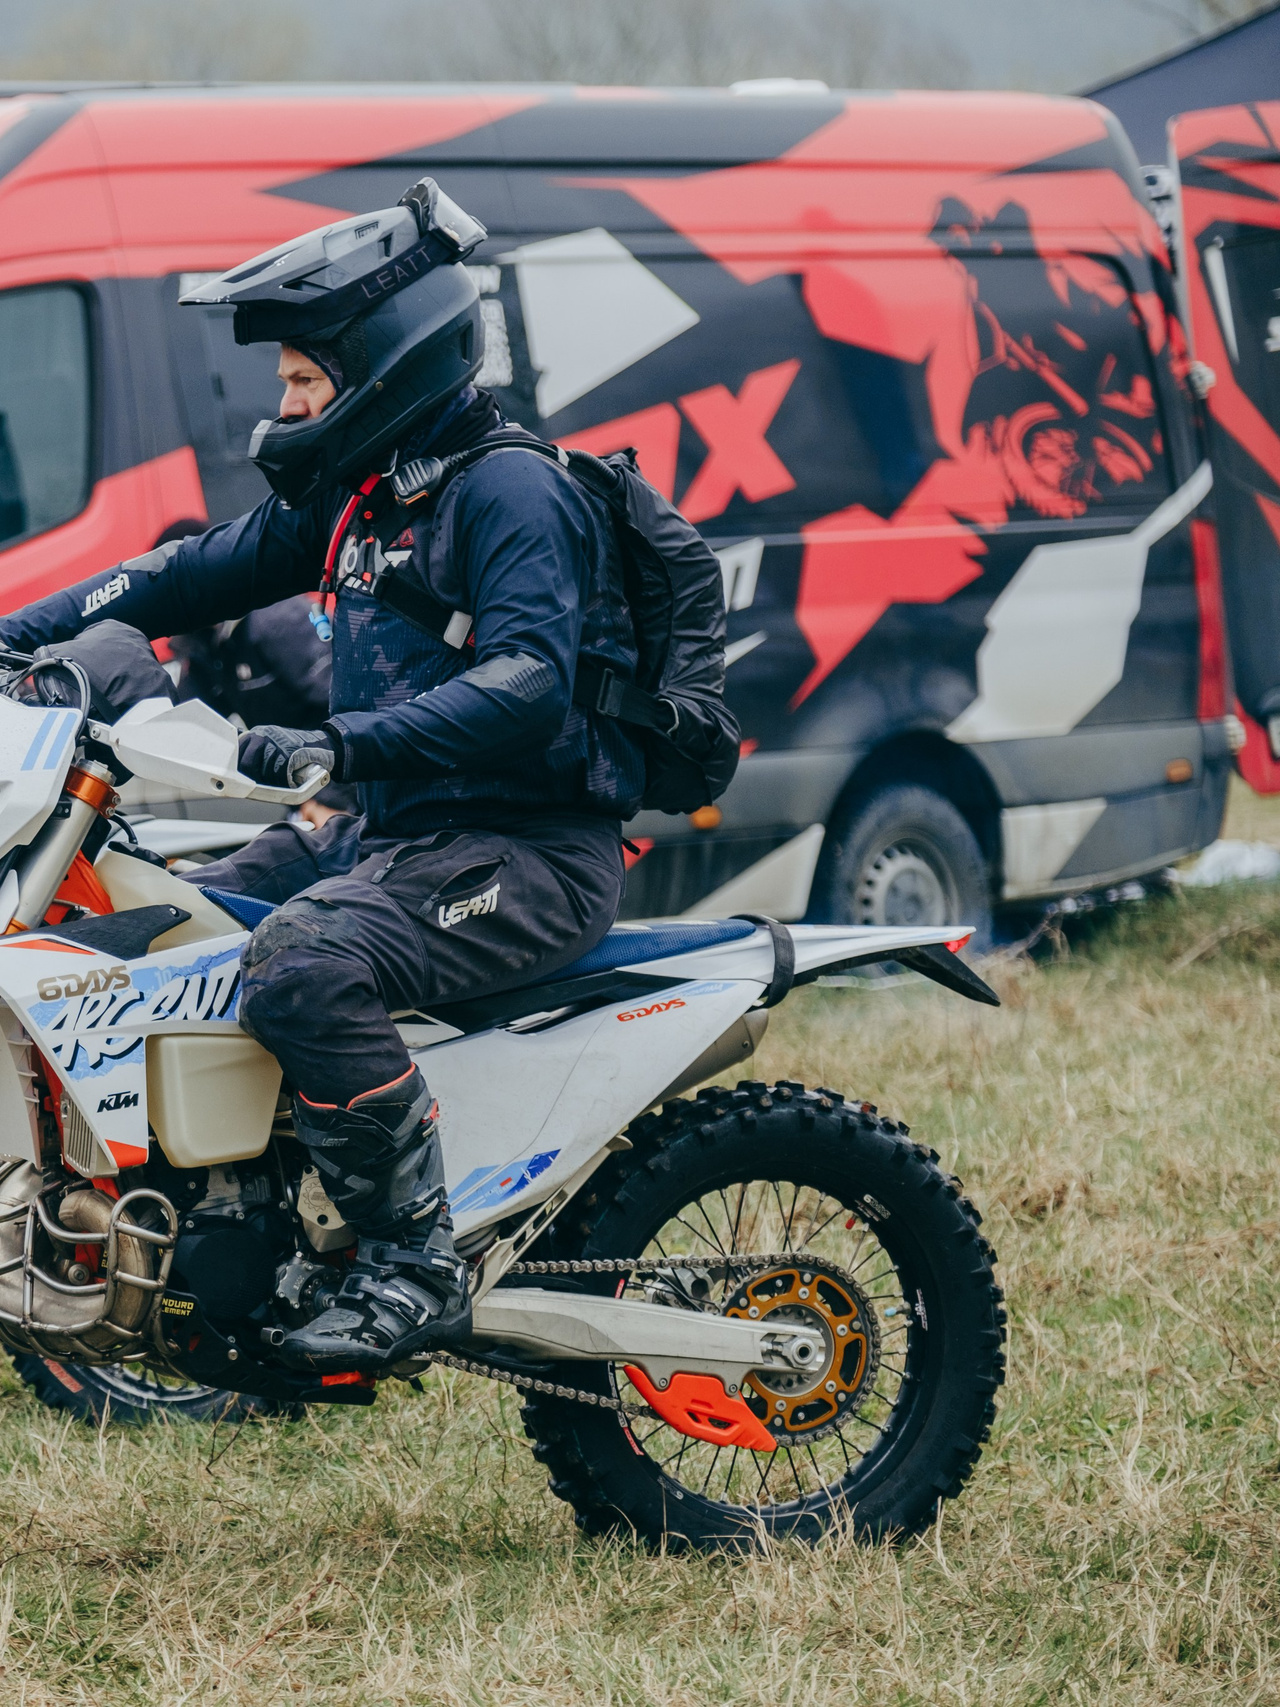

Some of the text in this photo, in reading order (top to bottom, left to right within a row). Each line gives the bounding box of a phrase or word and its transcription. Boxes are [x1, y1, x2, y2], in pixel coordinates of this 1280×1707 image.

[360, 245, 432, 299] LEATT
[81, 573, 130, 617] LEATT
[439, 883, 500, 928] LEATT
[36, 965, 131, 1001] 6DAYS
[616, 998, 686, 1022] 6DAYS
[97, 1091, 139, 1113] KTM
[161, 1298, 194, 1310] NDURO
[161, 1307, 192, 1317] EMENT
